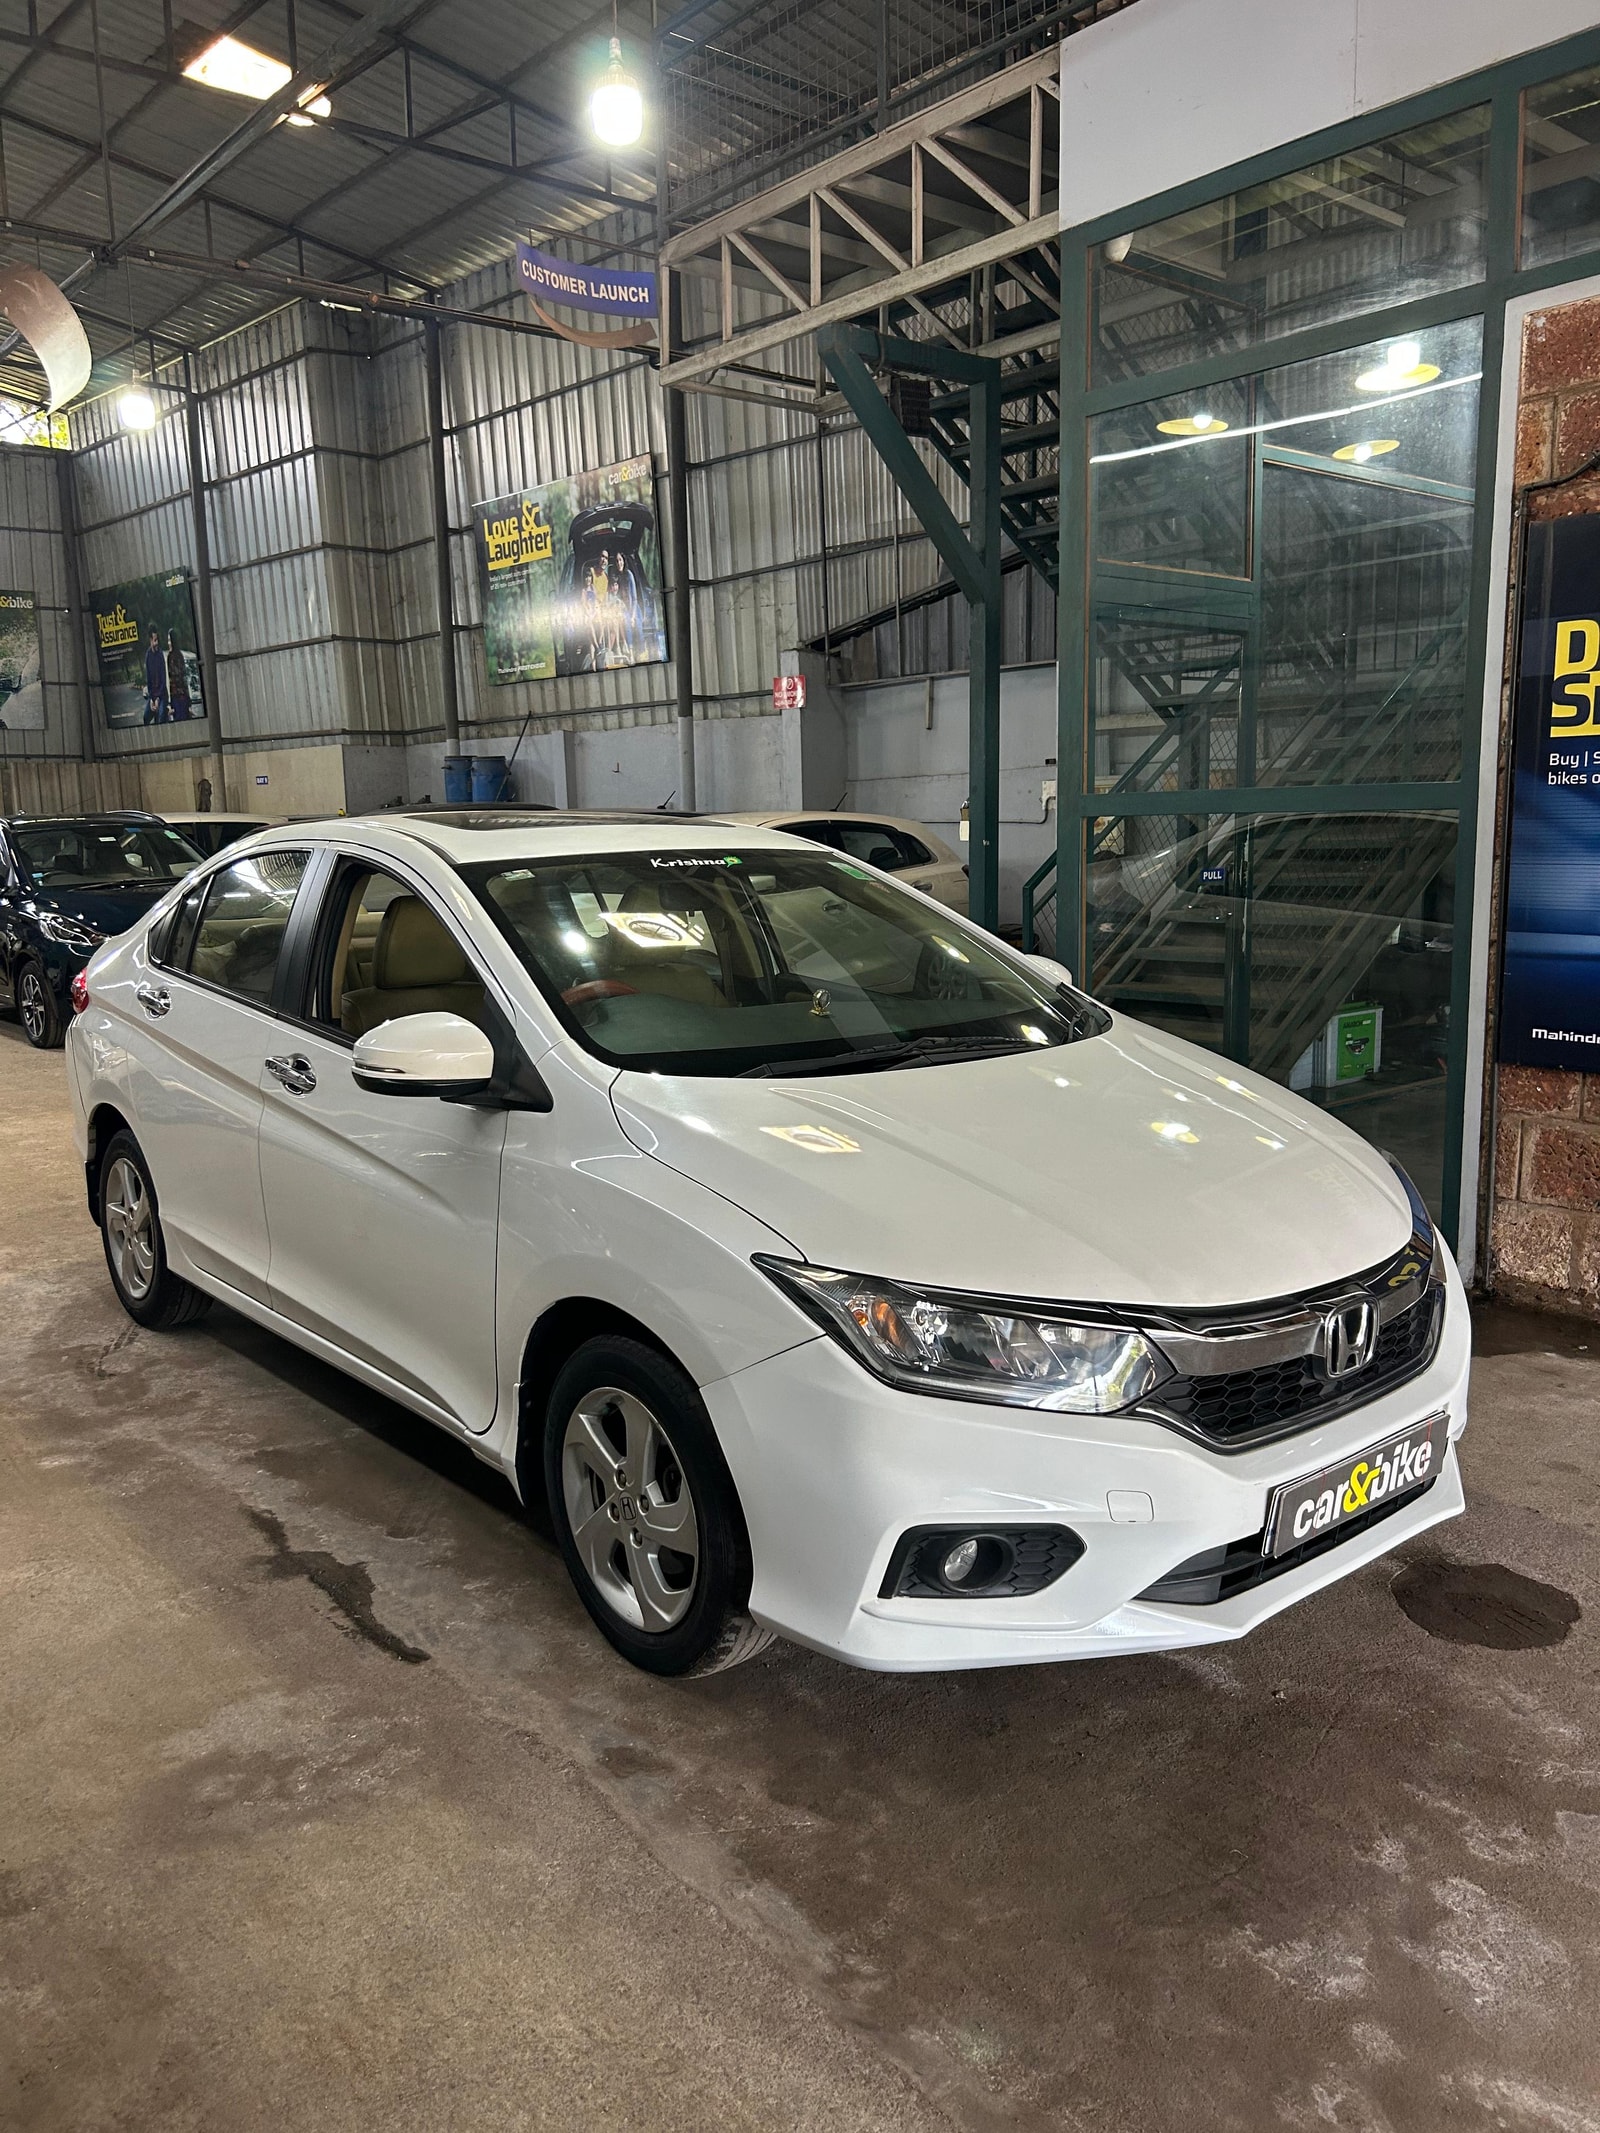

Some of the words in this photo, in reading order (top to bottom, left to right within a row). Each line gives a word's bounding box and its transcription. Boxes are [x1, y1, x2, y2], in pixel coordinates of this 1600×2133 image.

[522, 259, 588, 296] CUSTOMER
[590, 281, 650, 303] LAUNCH
[608, 462, 647, 486] car&bike
[484, 516, 518, 541] Love
[521, 499, 541, 531] &
[487, 529, 551, 564] Laughter
[96, 612, 116, 631] Trust
[115, 603, 127, 626] &
[99, 625, 138, 645] Assurance
[1551, 673, 1600, 728] S
[1549, 753, 1580, 769] Buy
[1548, 771, 1588, 785] bikes
[650, 857, 726, 868] Krishna
[1203, 870, 1222, 880] PULL
[1292, 1439, 1432, 1539] car&bike
